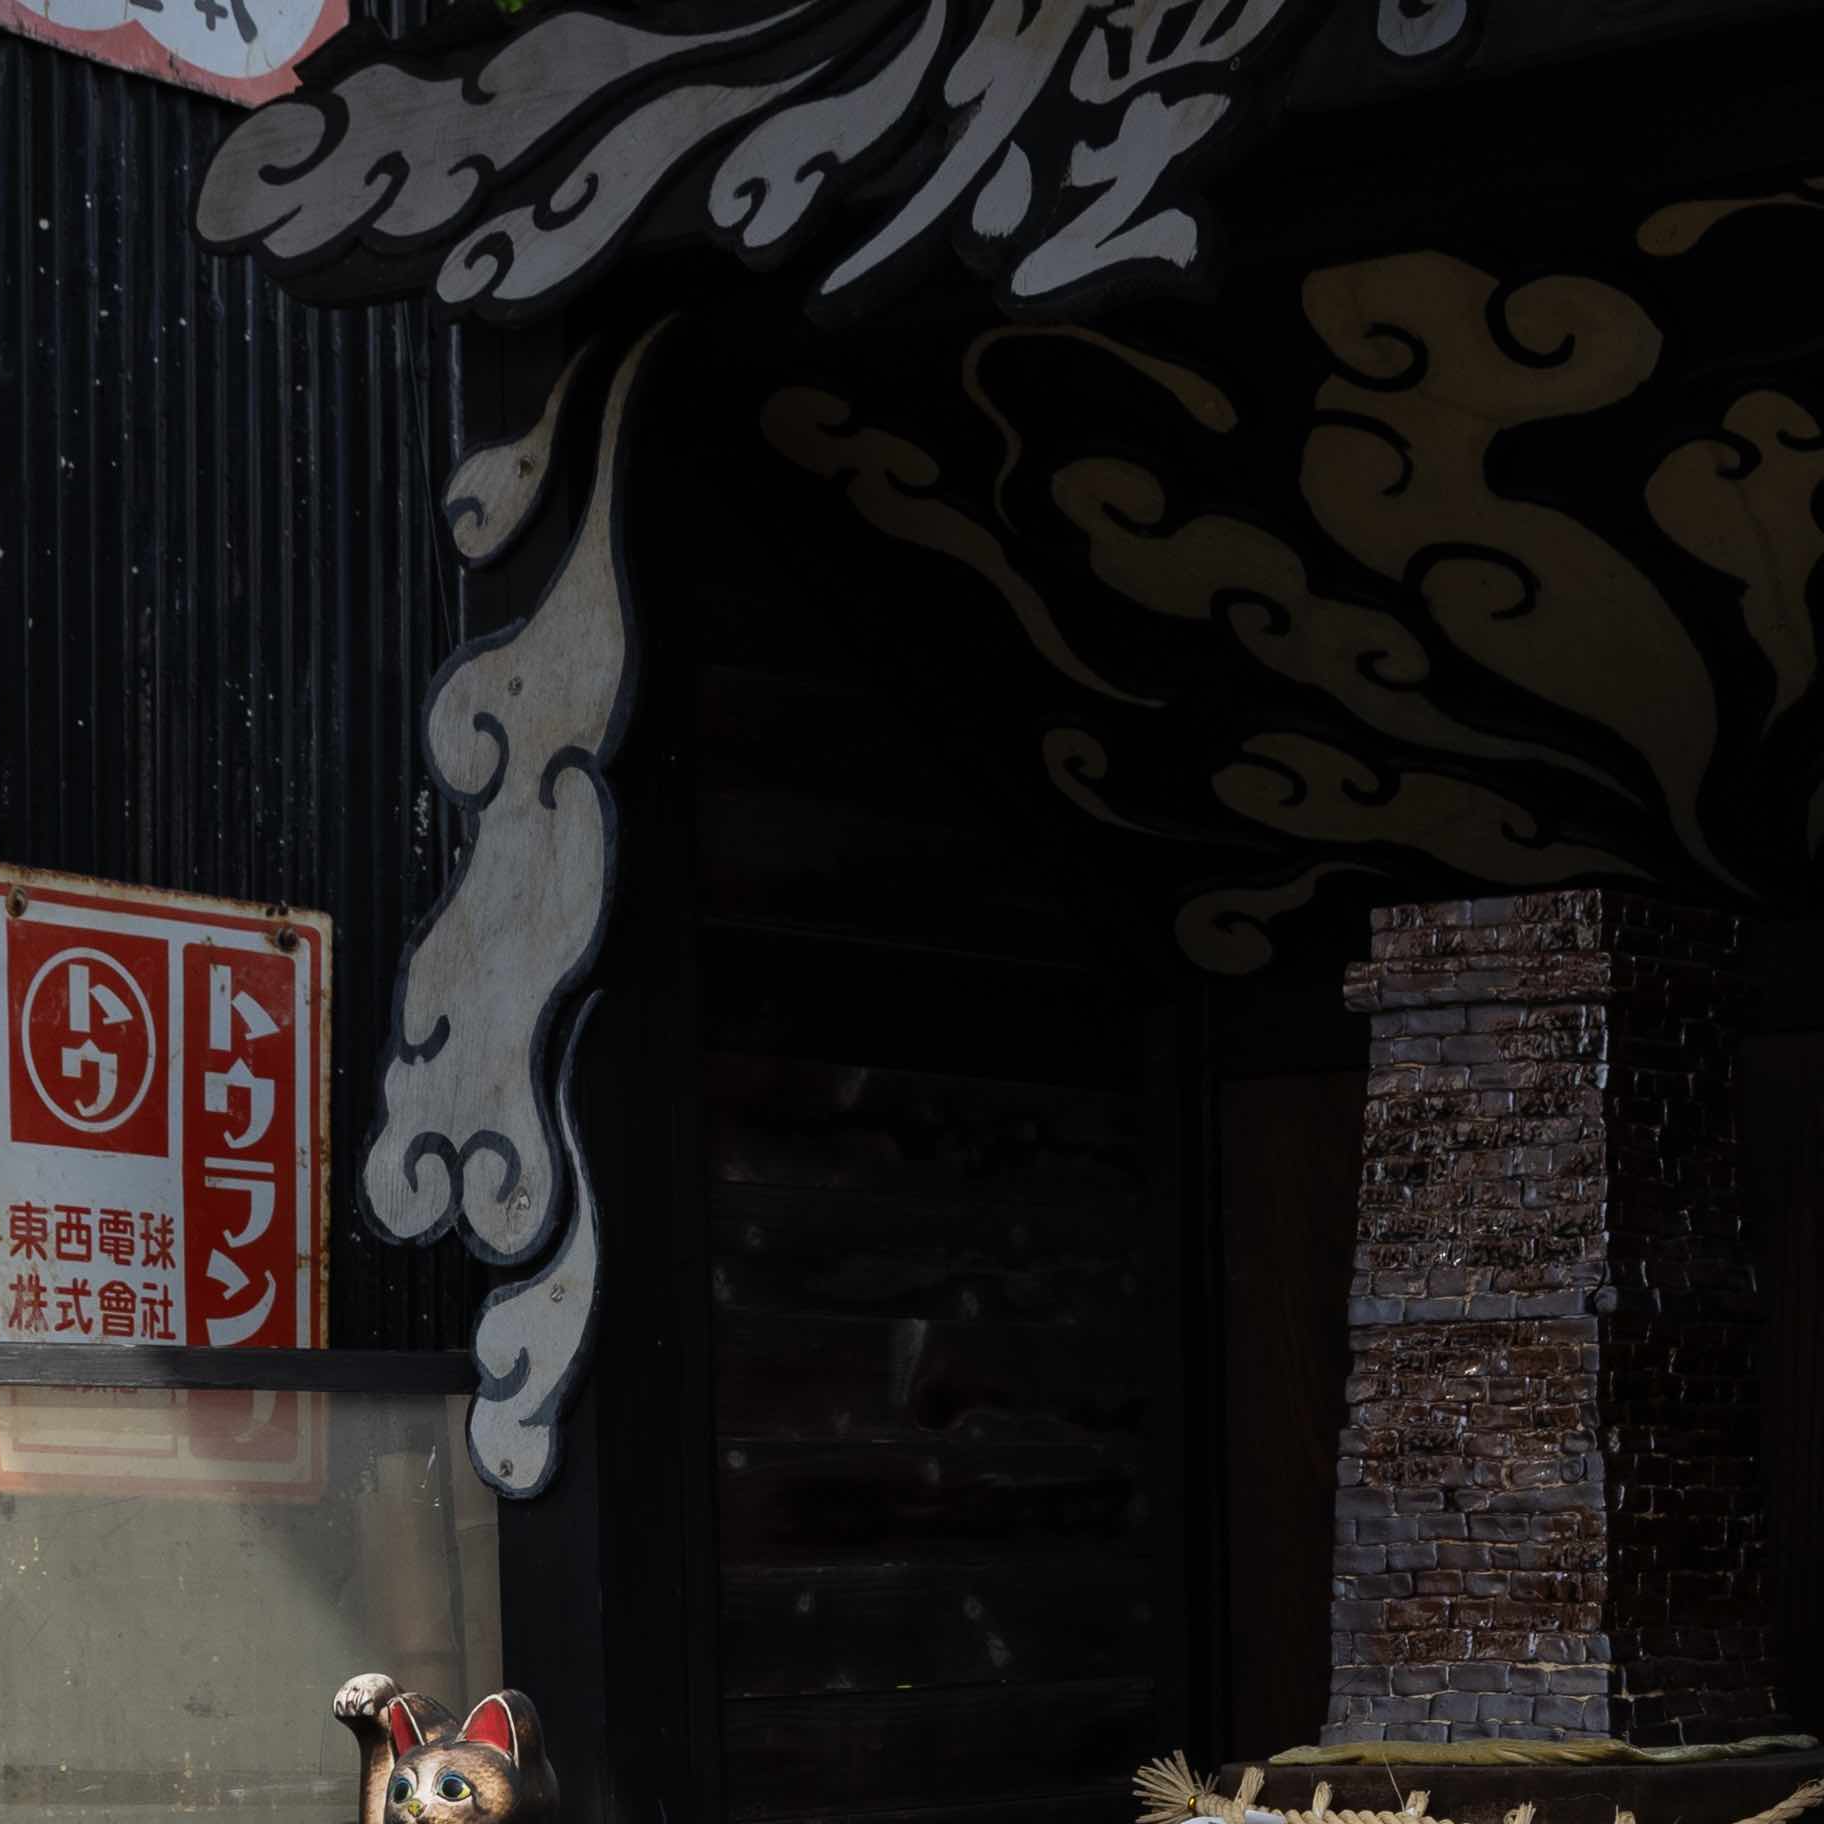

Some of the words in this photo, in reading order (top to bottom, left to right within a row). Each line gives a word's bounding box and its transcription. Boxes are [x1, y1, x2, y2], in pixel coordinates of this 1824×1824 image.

[61, 963, 134, 1117] トウ
[8, 1200, 176, 1270] 東西電球
[8, 1273, 176, 1342] 株式會社
